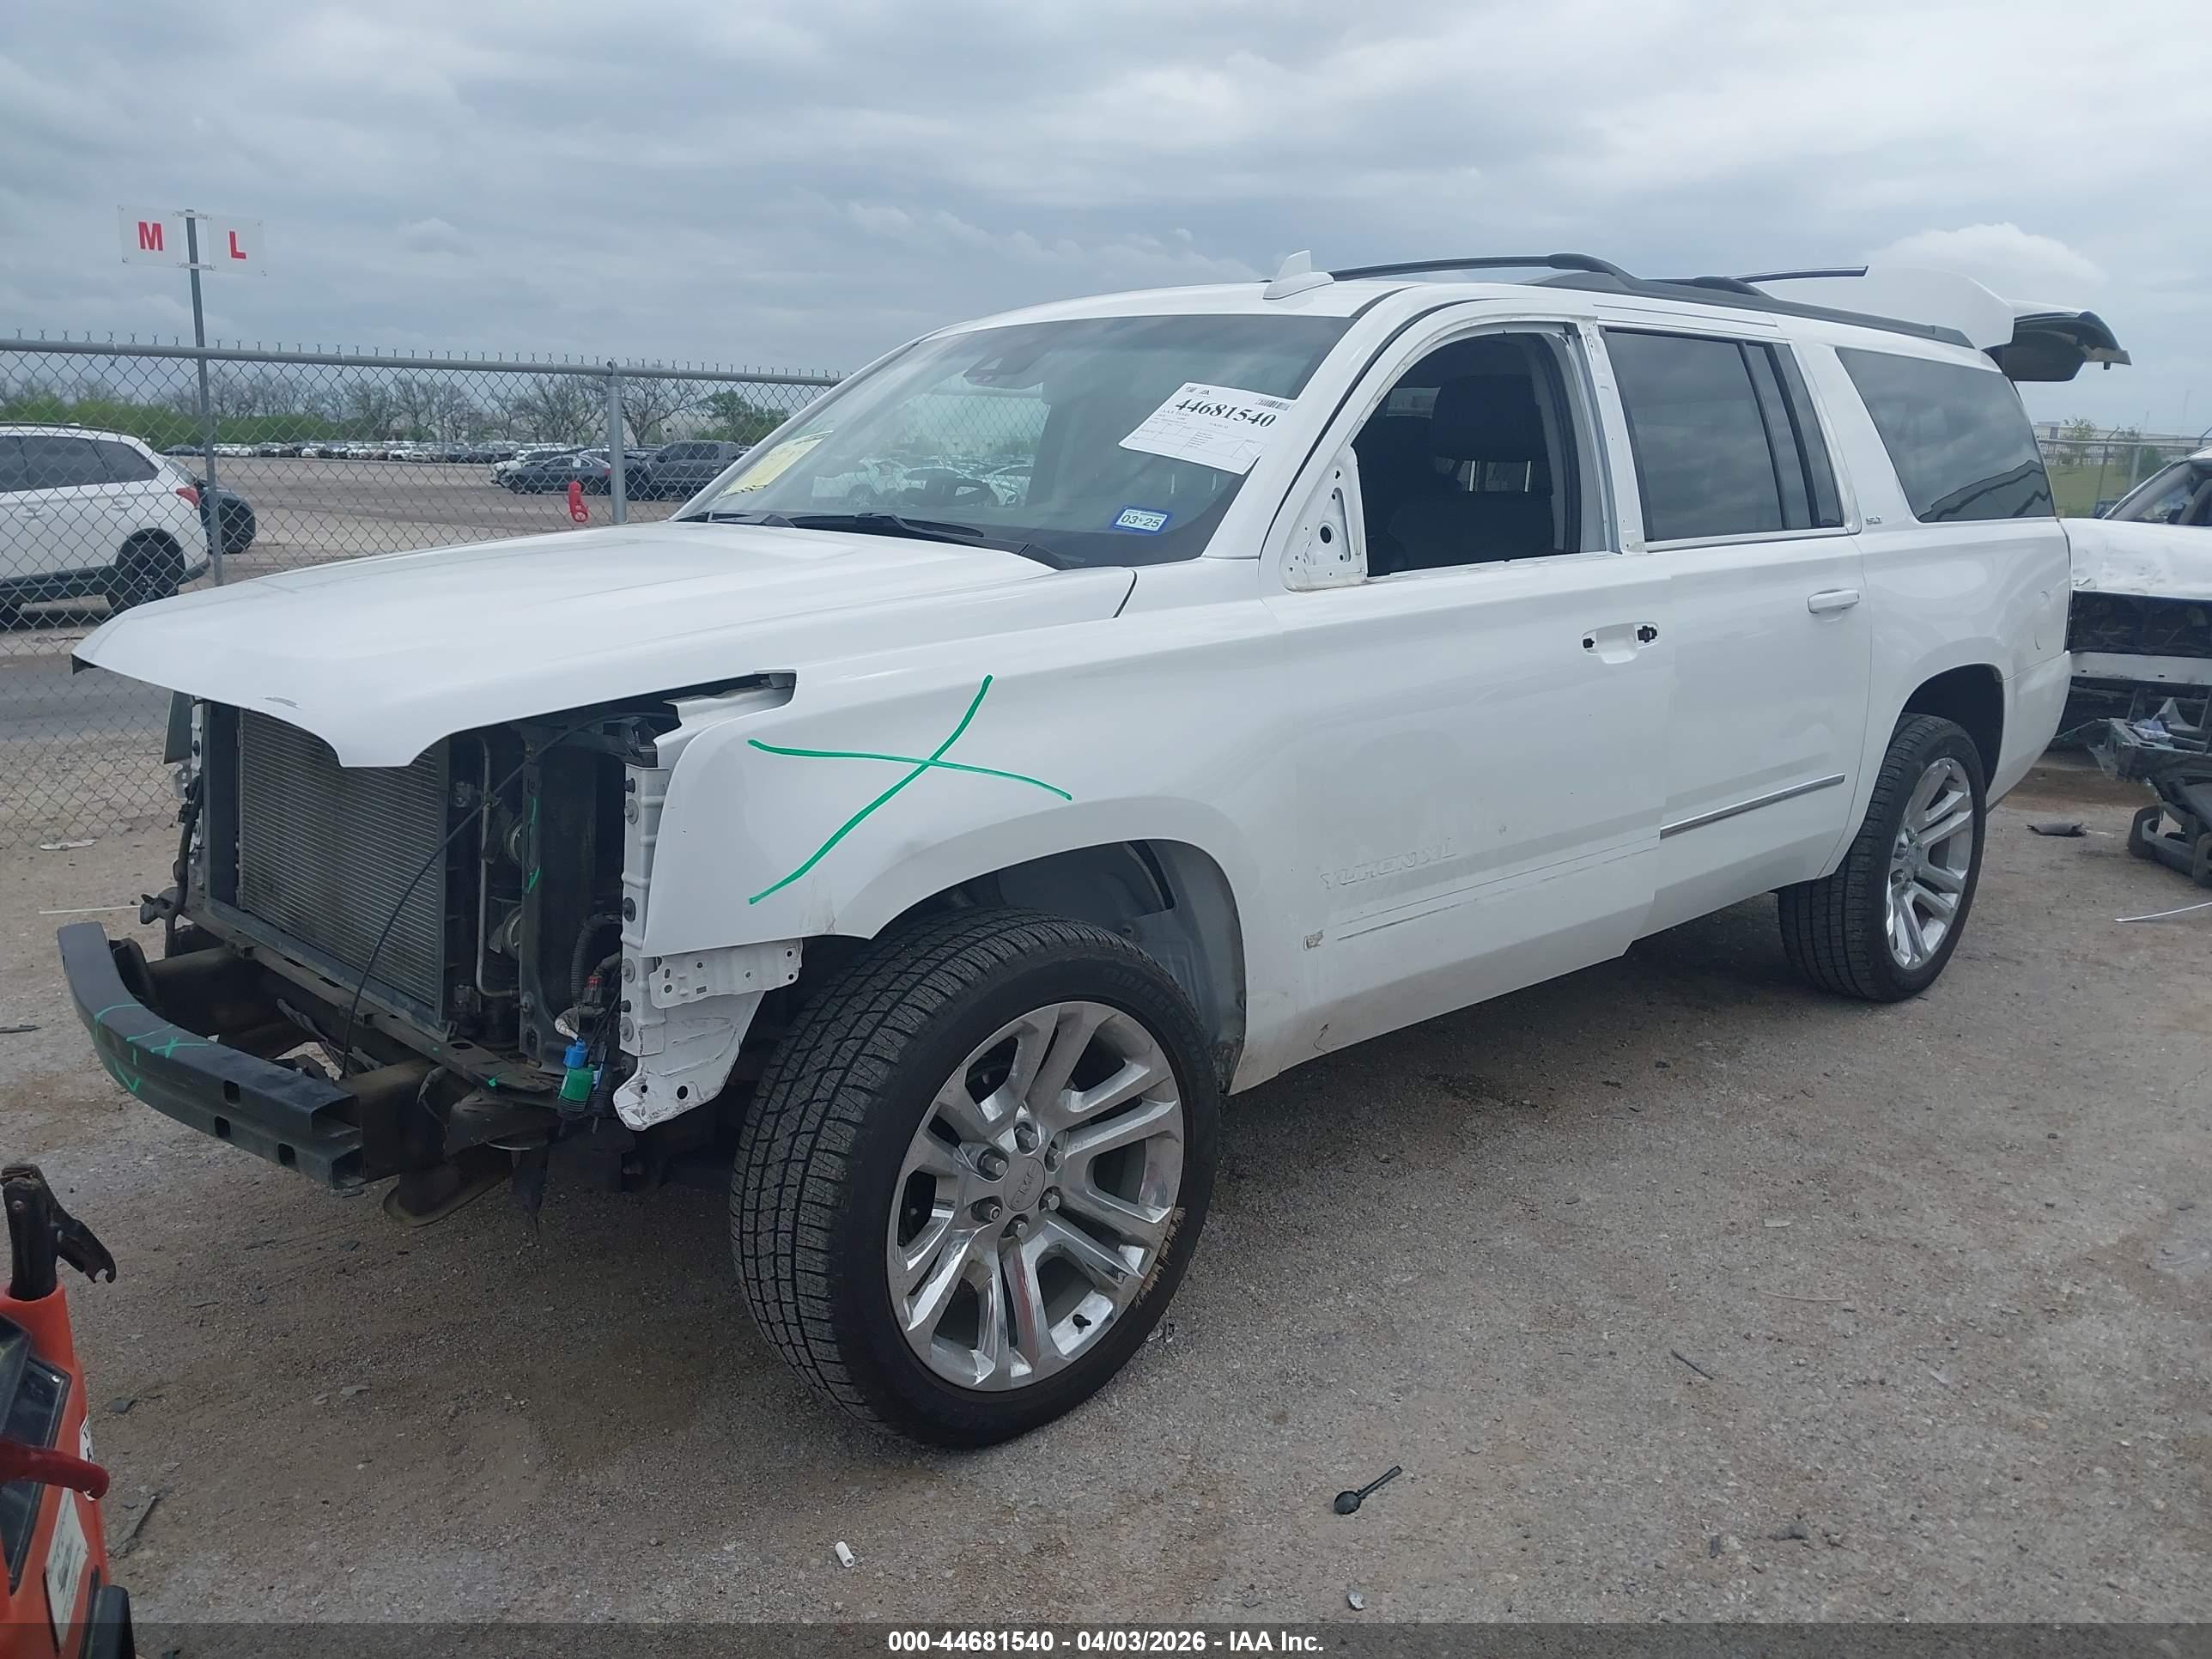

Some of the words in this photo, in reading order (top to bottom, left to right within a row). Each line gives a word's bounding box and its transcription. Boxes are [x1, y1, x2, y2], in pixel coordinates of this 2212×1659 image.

[138, 222, 163, 251] M
[229, 231, 246, 259] L
[1175, 398, 1277, 428] 44681540
[1121, 514, 1139, 524] 03
[1143, 518, 1162, 527] 25
